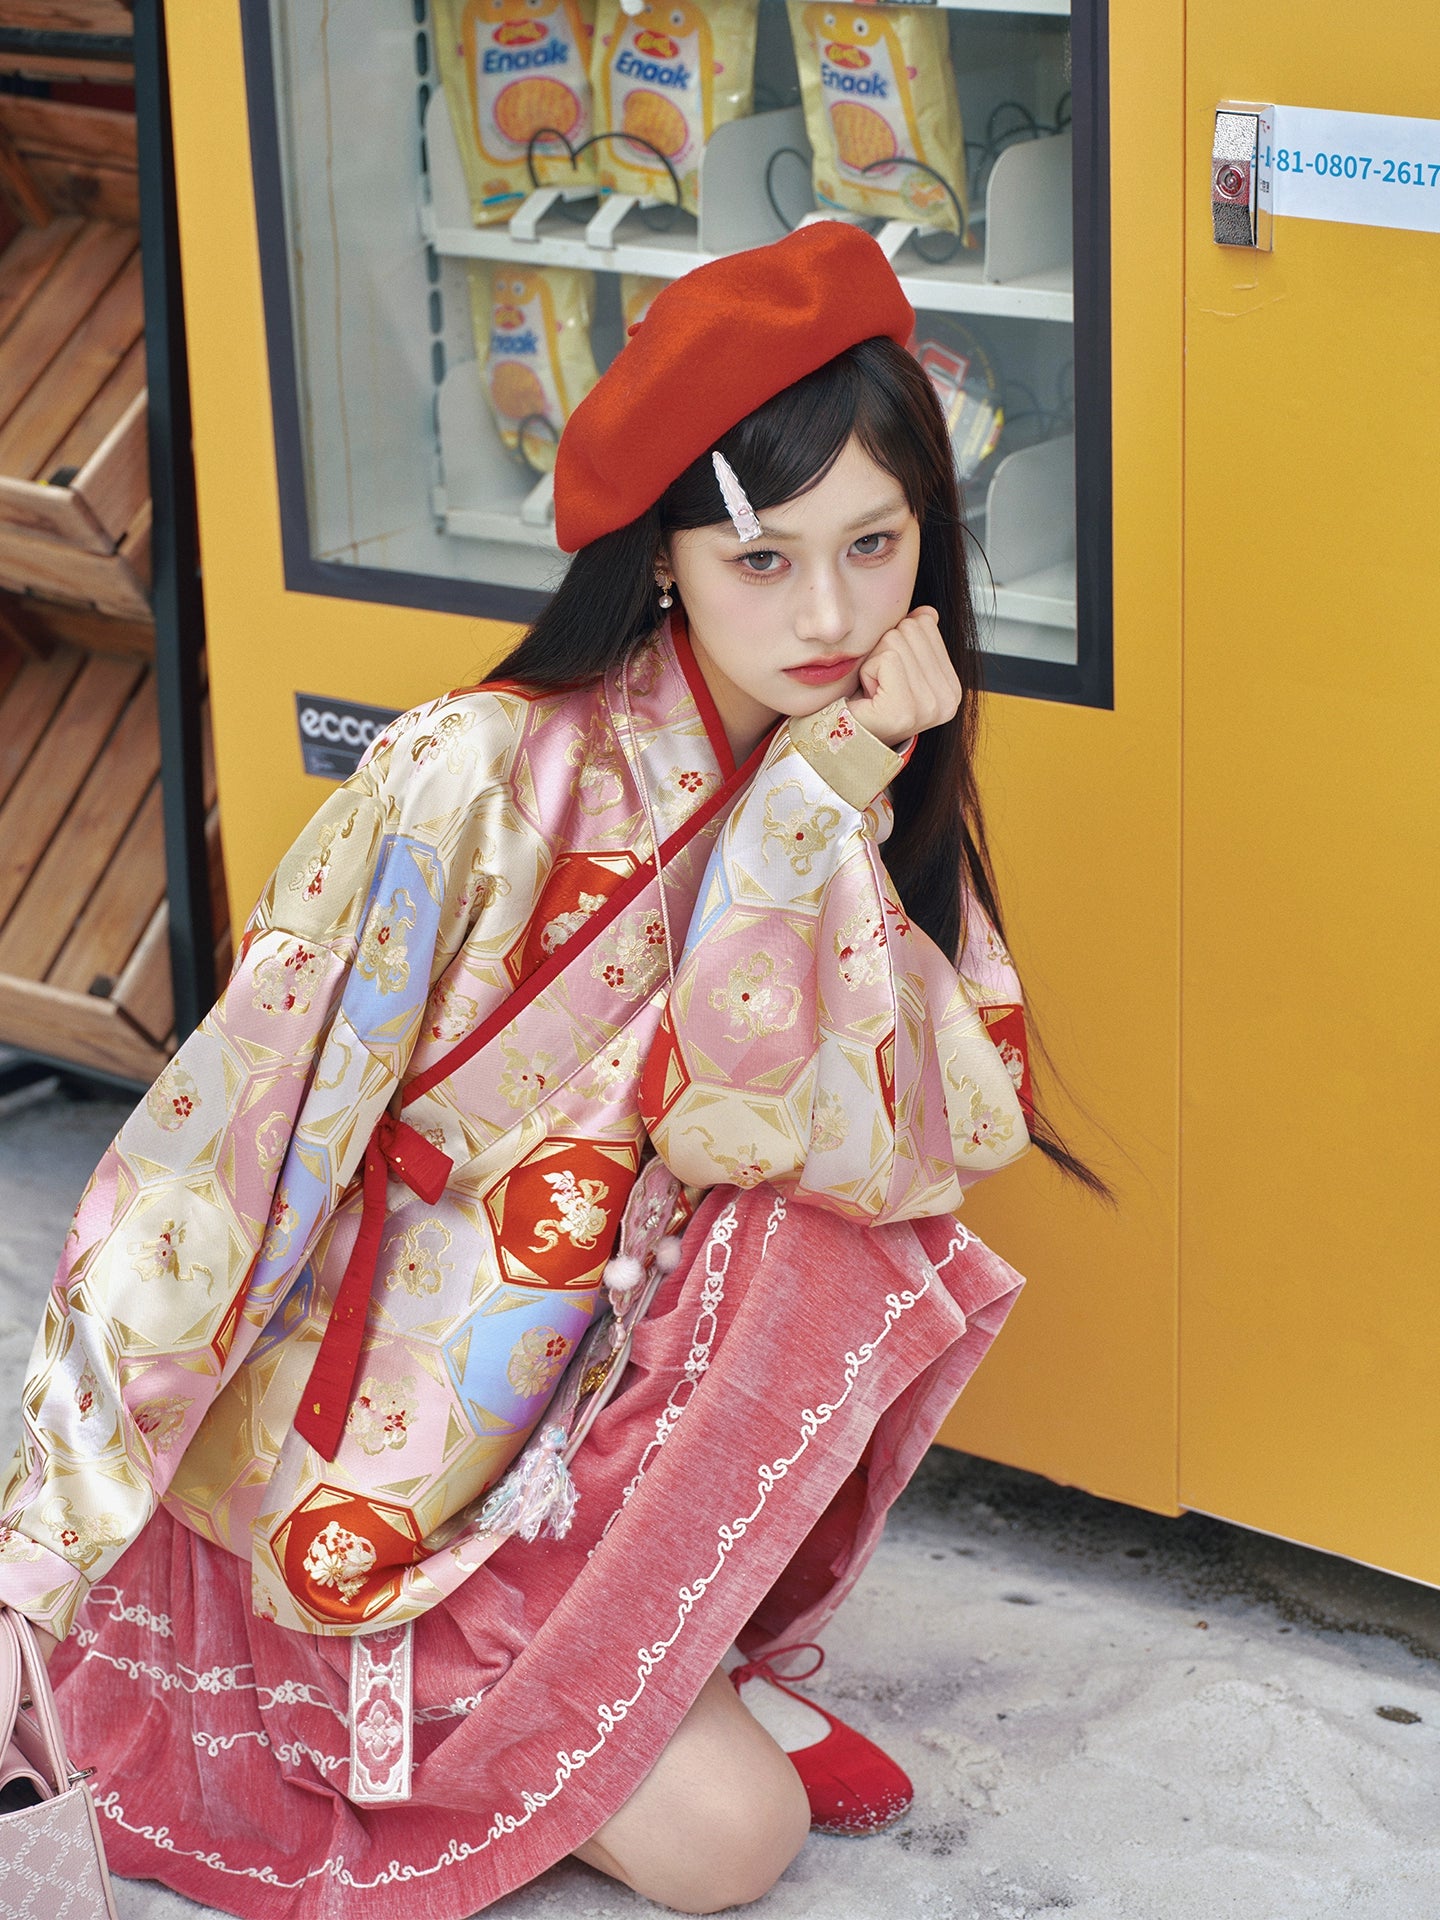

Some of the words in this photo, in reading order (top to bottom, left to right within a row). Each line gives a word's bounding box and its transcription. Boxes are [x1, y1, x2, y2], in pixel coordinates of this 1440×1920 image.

[482, 38, 569, 75] Enaak
[615, 50, 691, 90] Enaak
[1272, 148, 1440, 187] 81-0807-2617
